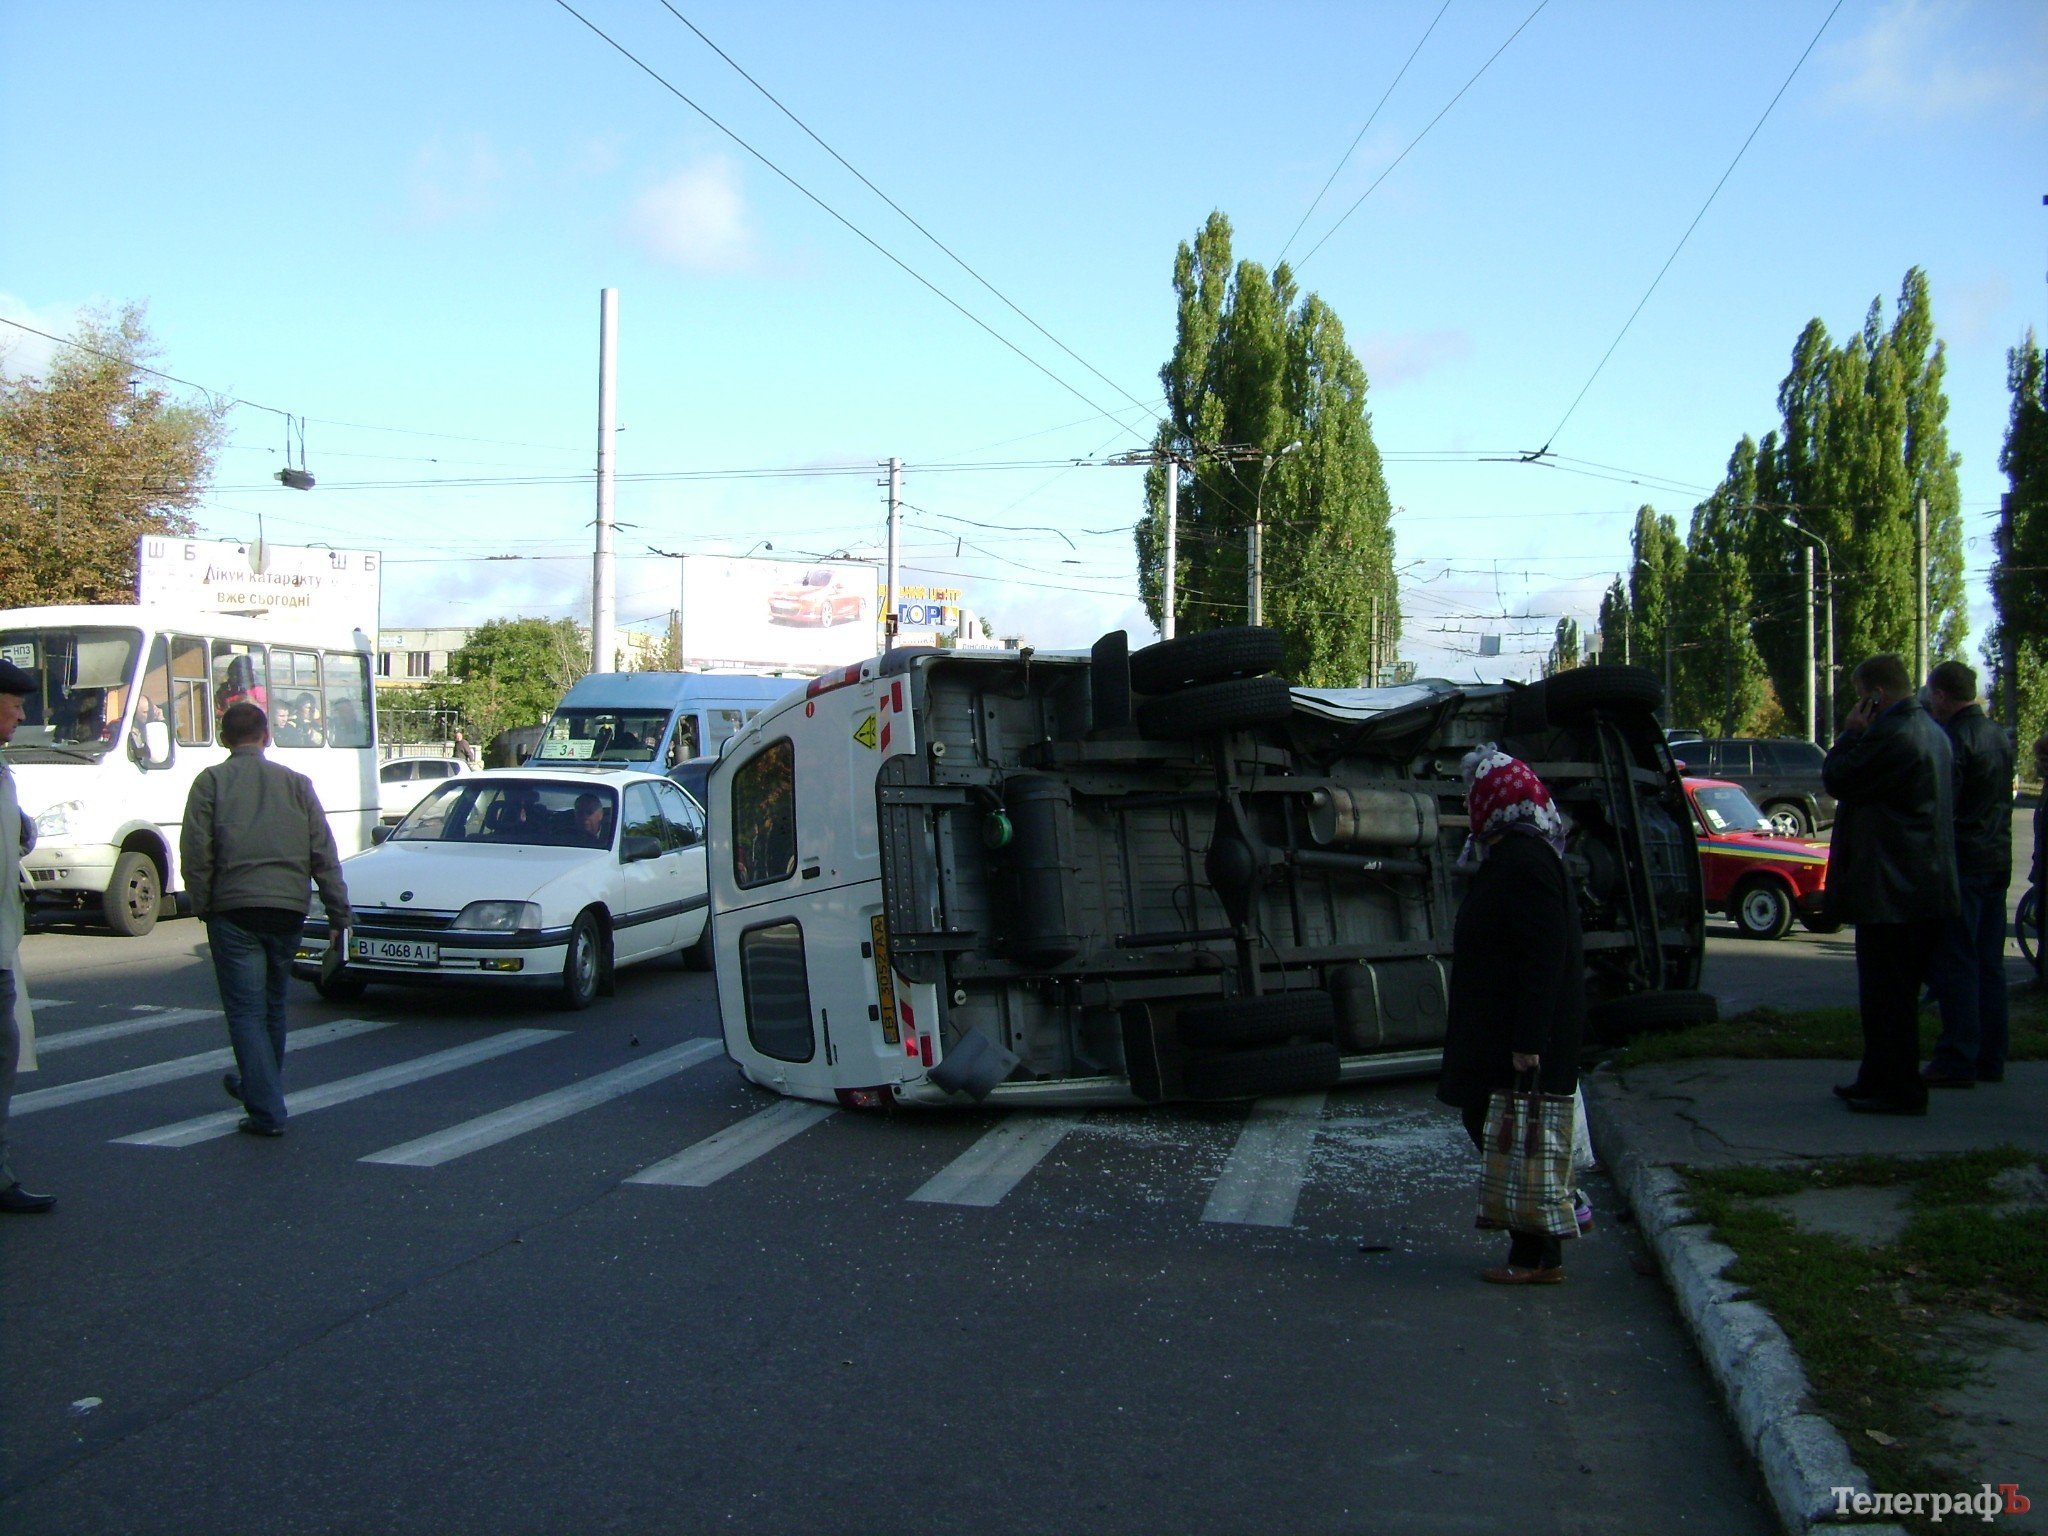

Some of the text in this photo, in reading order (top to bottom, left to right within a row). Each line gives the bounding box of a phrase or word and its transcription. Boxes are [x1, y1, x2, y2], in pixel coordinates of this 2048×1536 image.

[217, 592, 311, 608] вже сьогодні
[381, 943, 411, 958] 4068
